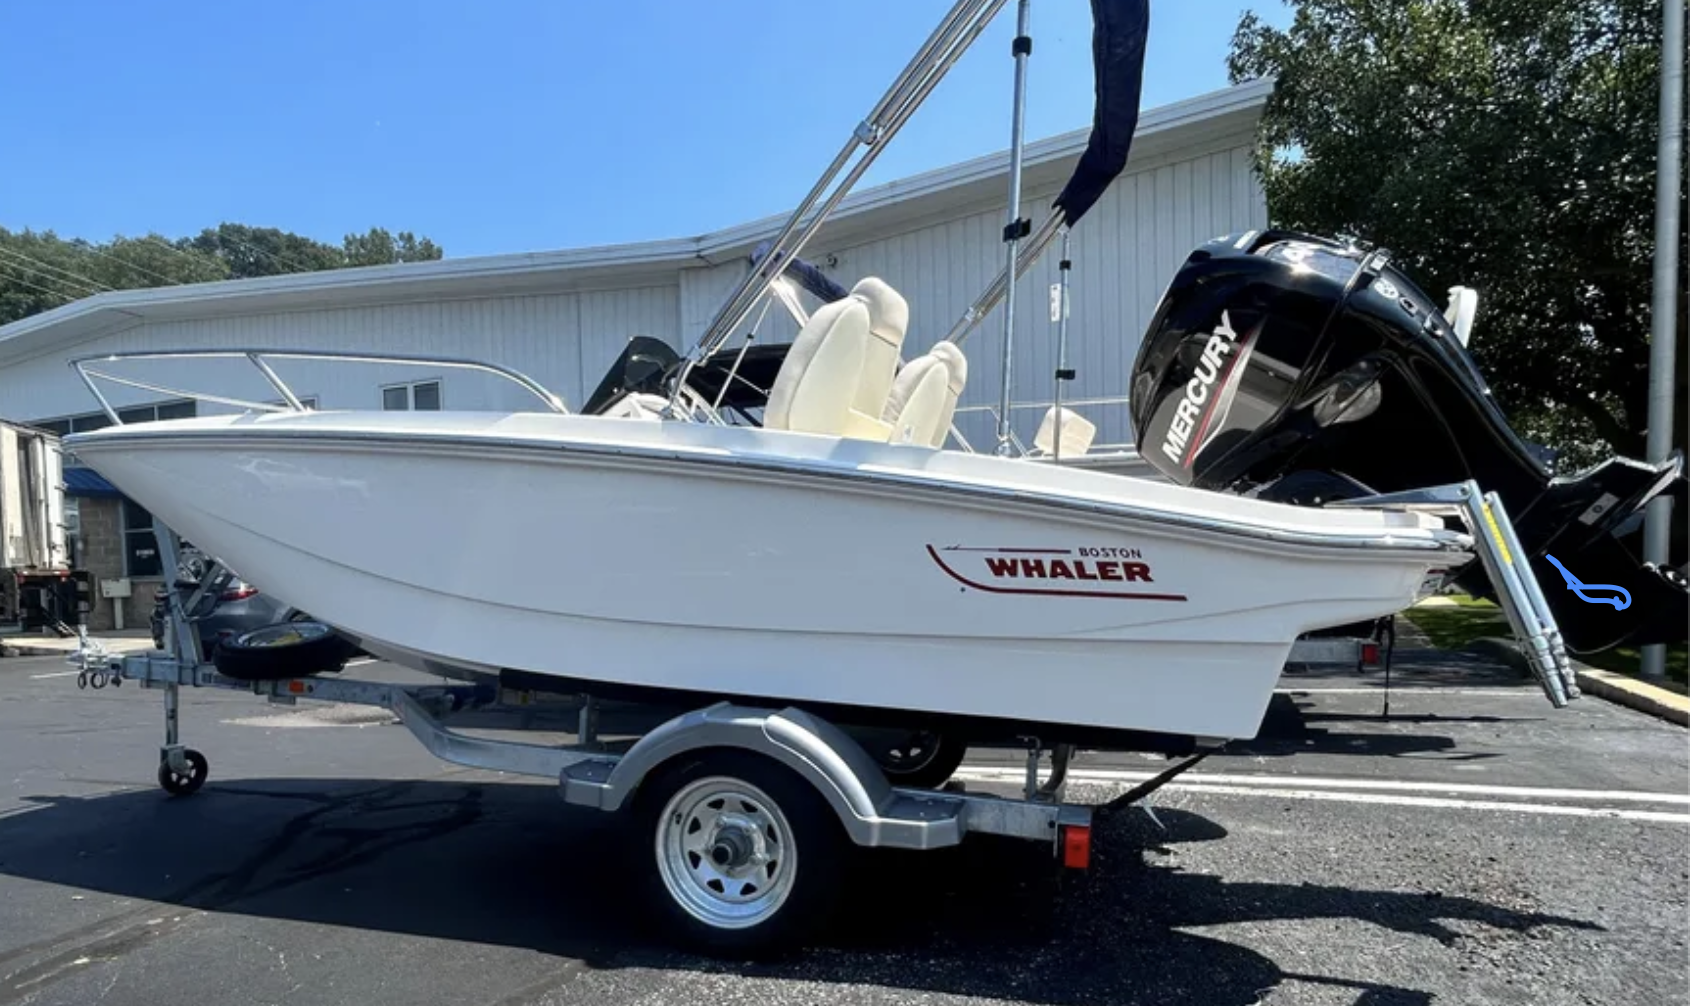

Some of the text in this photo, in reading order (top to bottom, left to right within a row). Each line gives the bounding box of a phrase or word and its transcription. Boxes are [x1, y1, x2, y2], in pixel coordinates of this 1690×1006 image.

[1162, 309, 1237, 464] MERCURY
[1078, 547, 1142, 559] BOSTON
[984, 557, 1154, 582] WHALER
